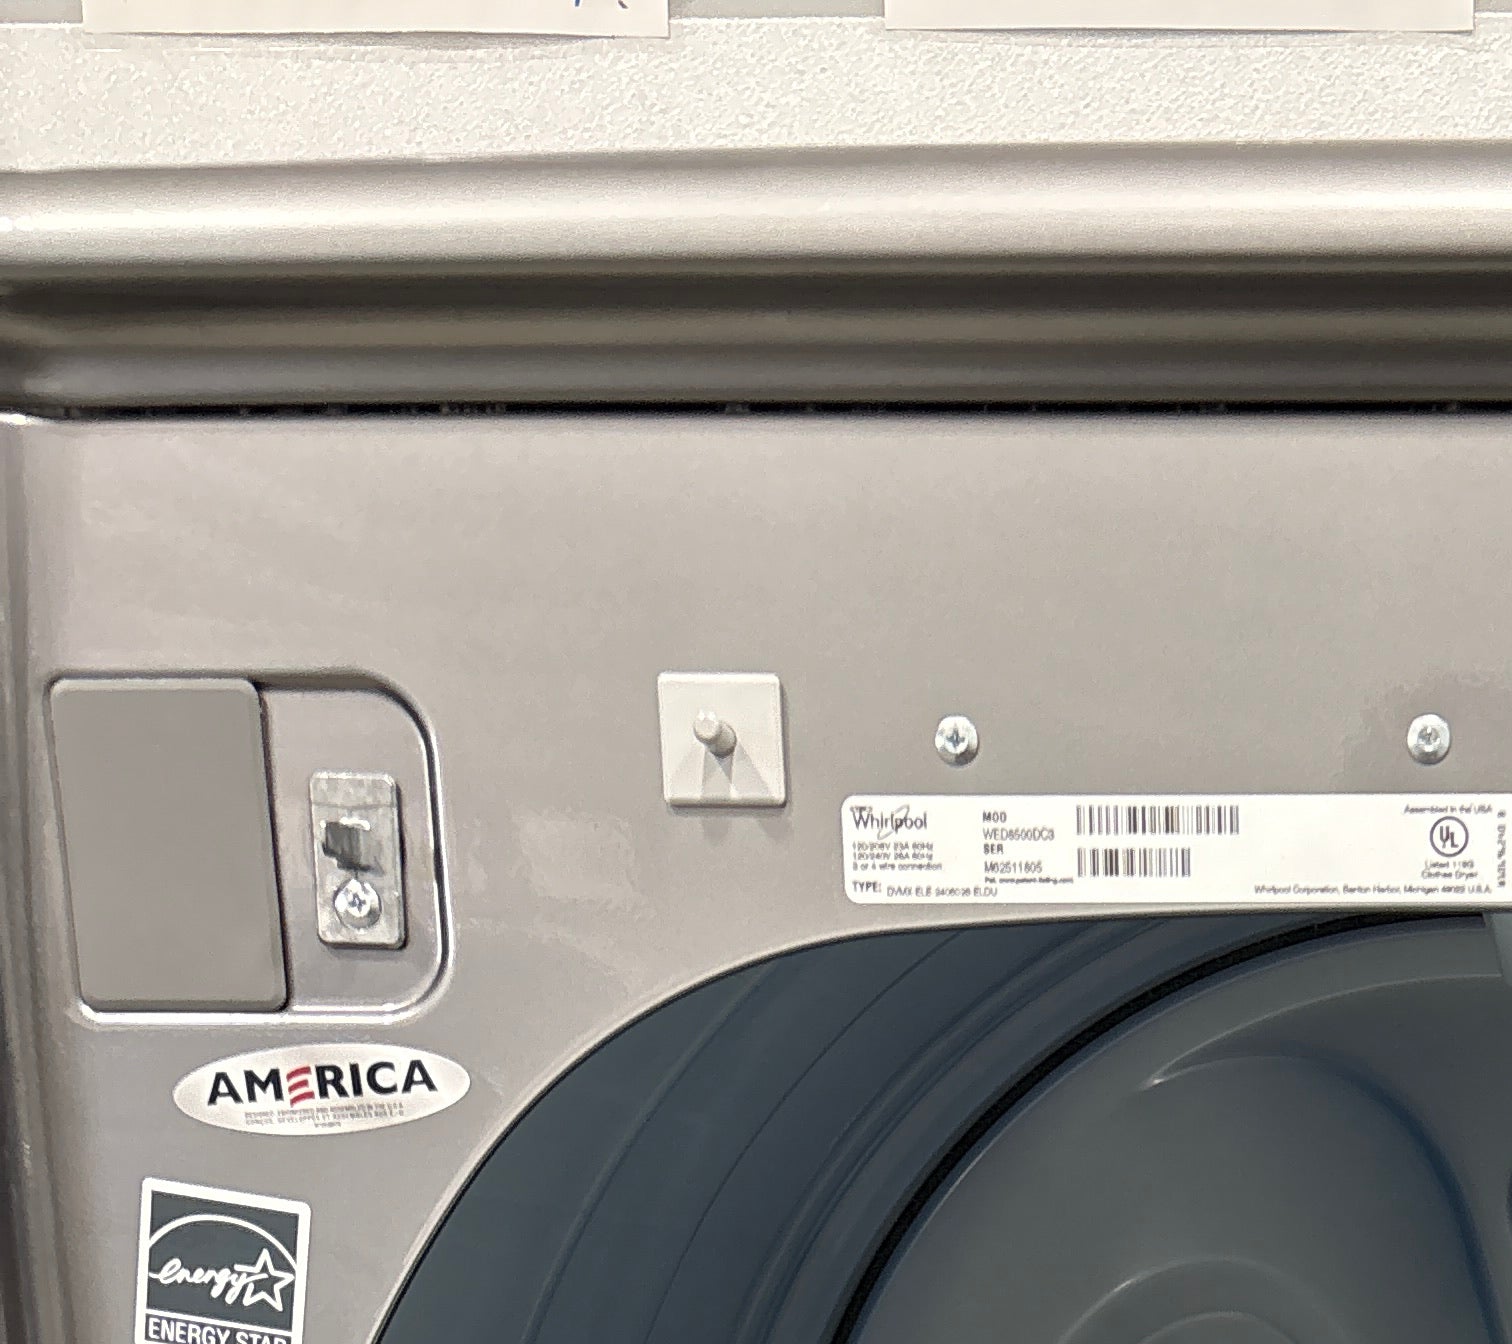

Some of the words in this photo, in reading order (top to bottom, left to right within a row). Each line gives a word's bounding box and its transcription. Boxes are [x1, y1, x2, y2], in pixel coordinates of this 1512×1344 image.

[851, 809, 927, 834] Whirlpool
[982, 811, 1007, 823] MOD
[983, 843, 1004, 855] SER
[1439, 825, 1459, 849] UL
[207, 1059, 438, 1107] AMERICA
[149, 1257, 258, 1305] energy
